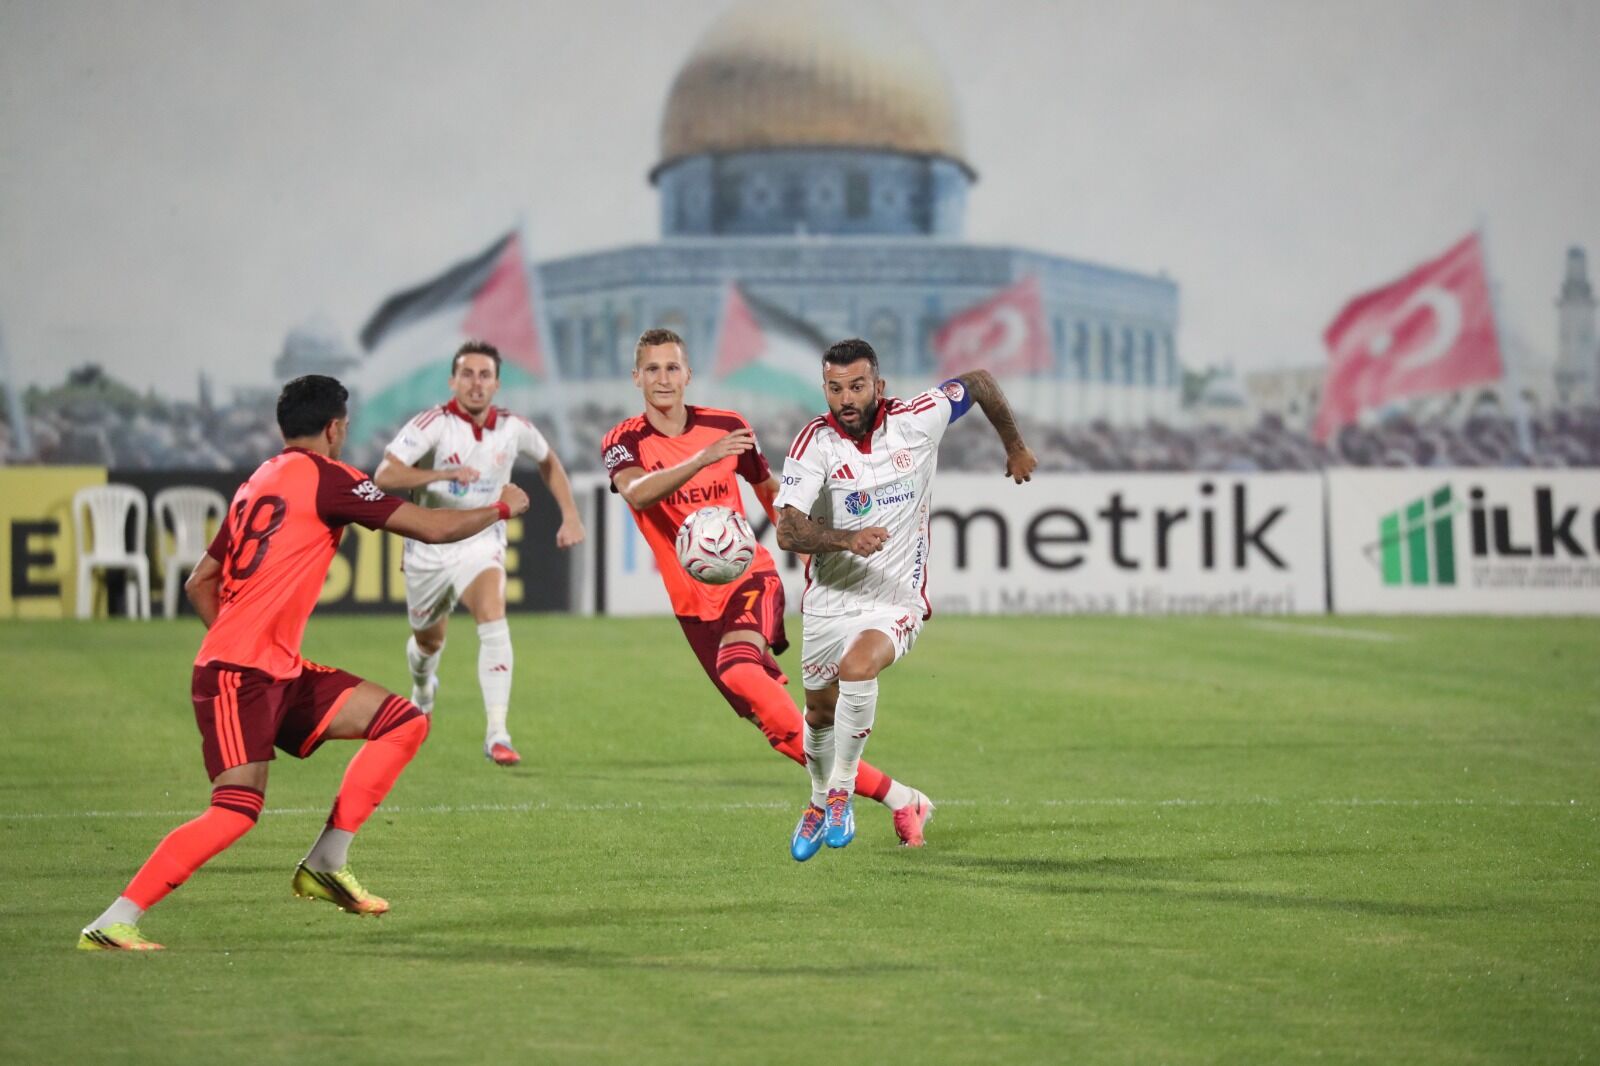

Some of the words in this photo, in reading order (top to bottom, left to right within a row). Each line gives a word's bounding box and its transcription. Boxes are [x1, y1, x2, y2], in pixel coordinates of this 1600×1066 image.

[10, 520, 61, 598] E
[229, 496, 286, 580] 18
[741, 590, 761, 611] 7
